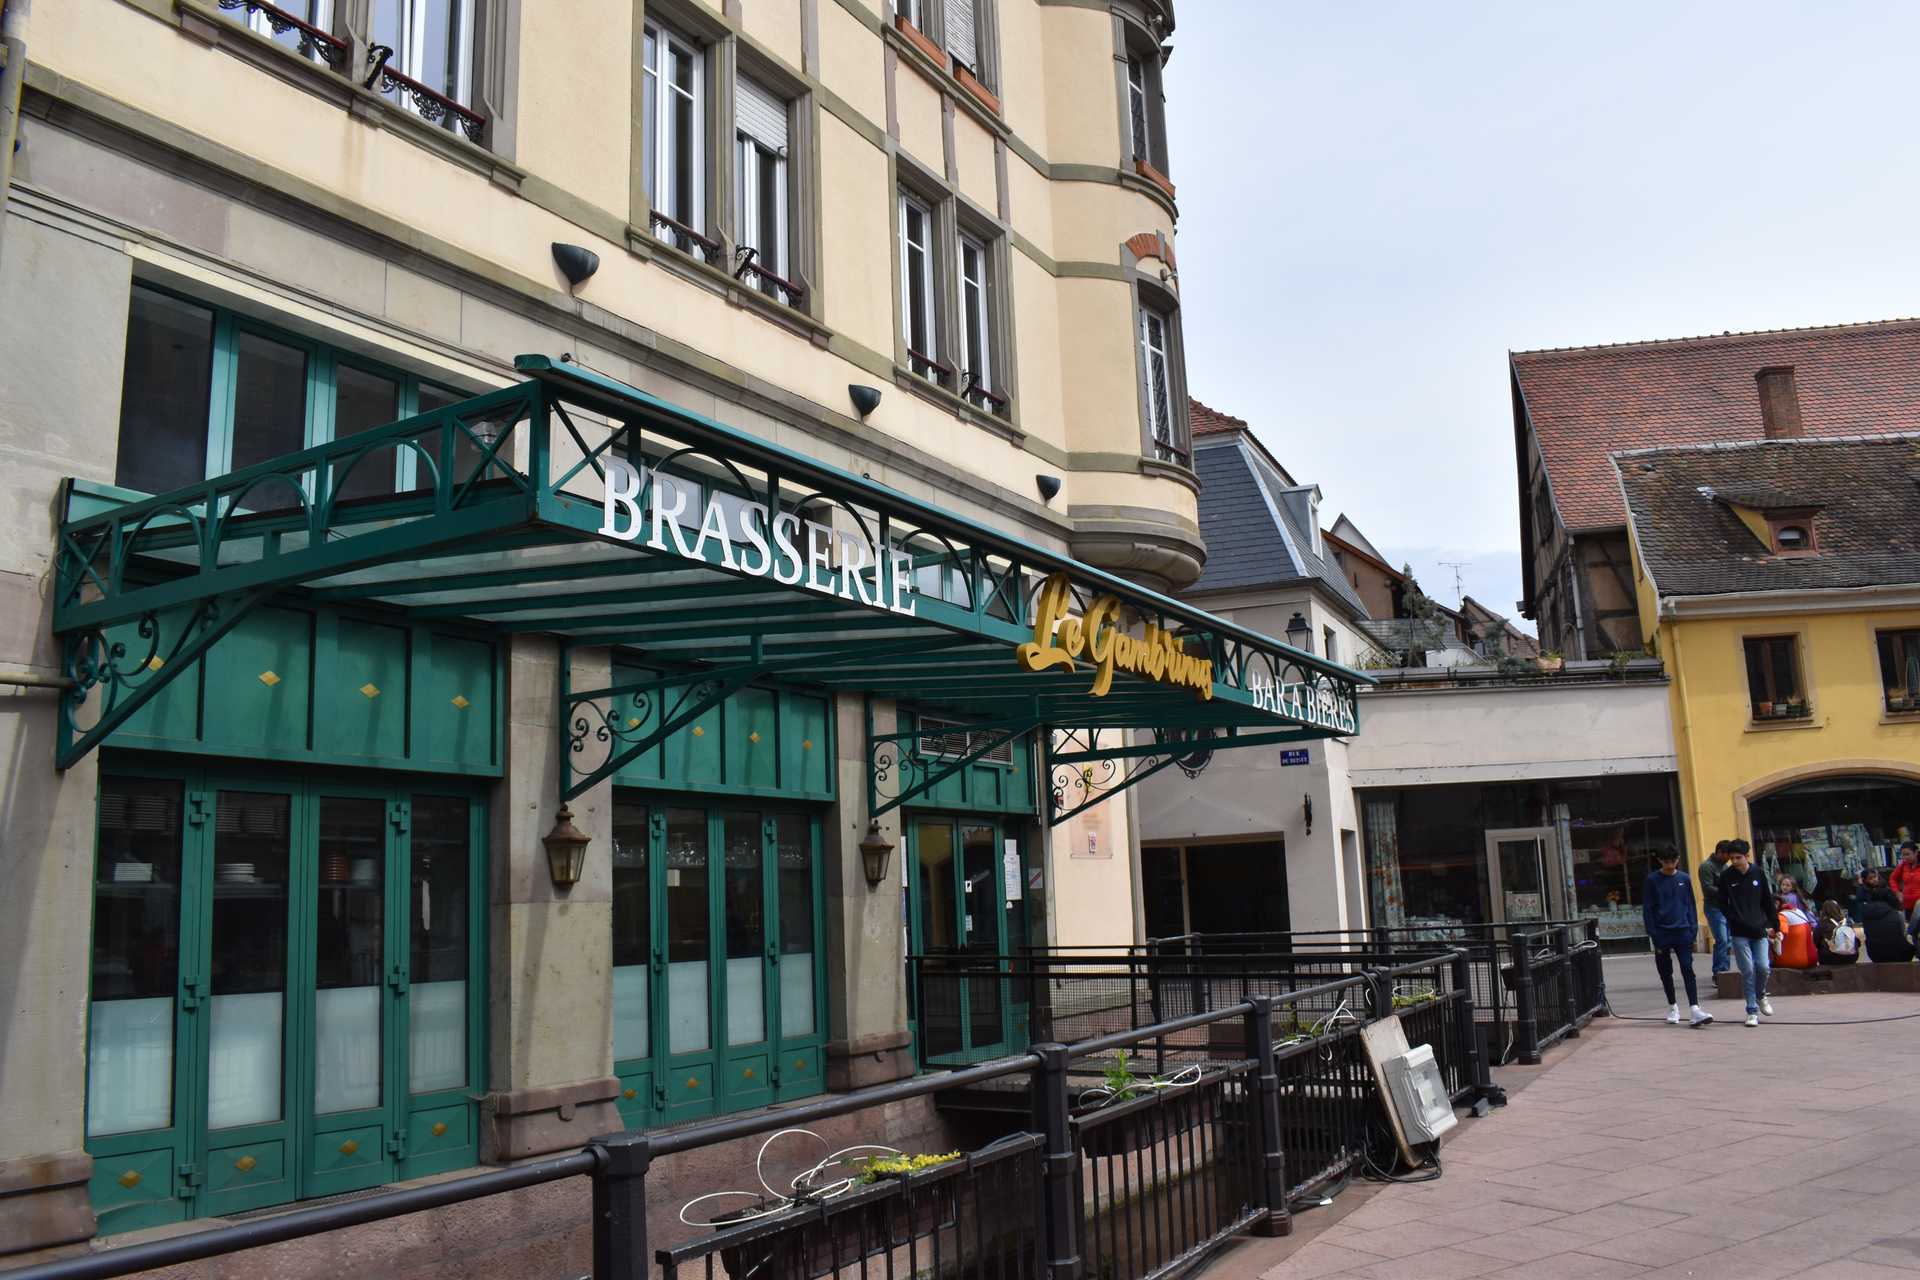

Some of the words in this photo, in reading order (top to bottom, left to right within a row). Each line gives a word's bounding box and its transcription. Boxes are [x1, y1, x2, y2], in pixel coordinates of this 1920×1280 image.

[598, 455, 916, 617] BRASSERIE
[1017, 572, 1085, 674] Le
[1252, 671, 1289, 717] BAR
